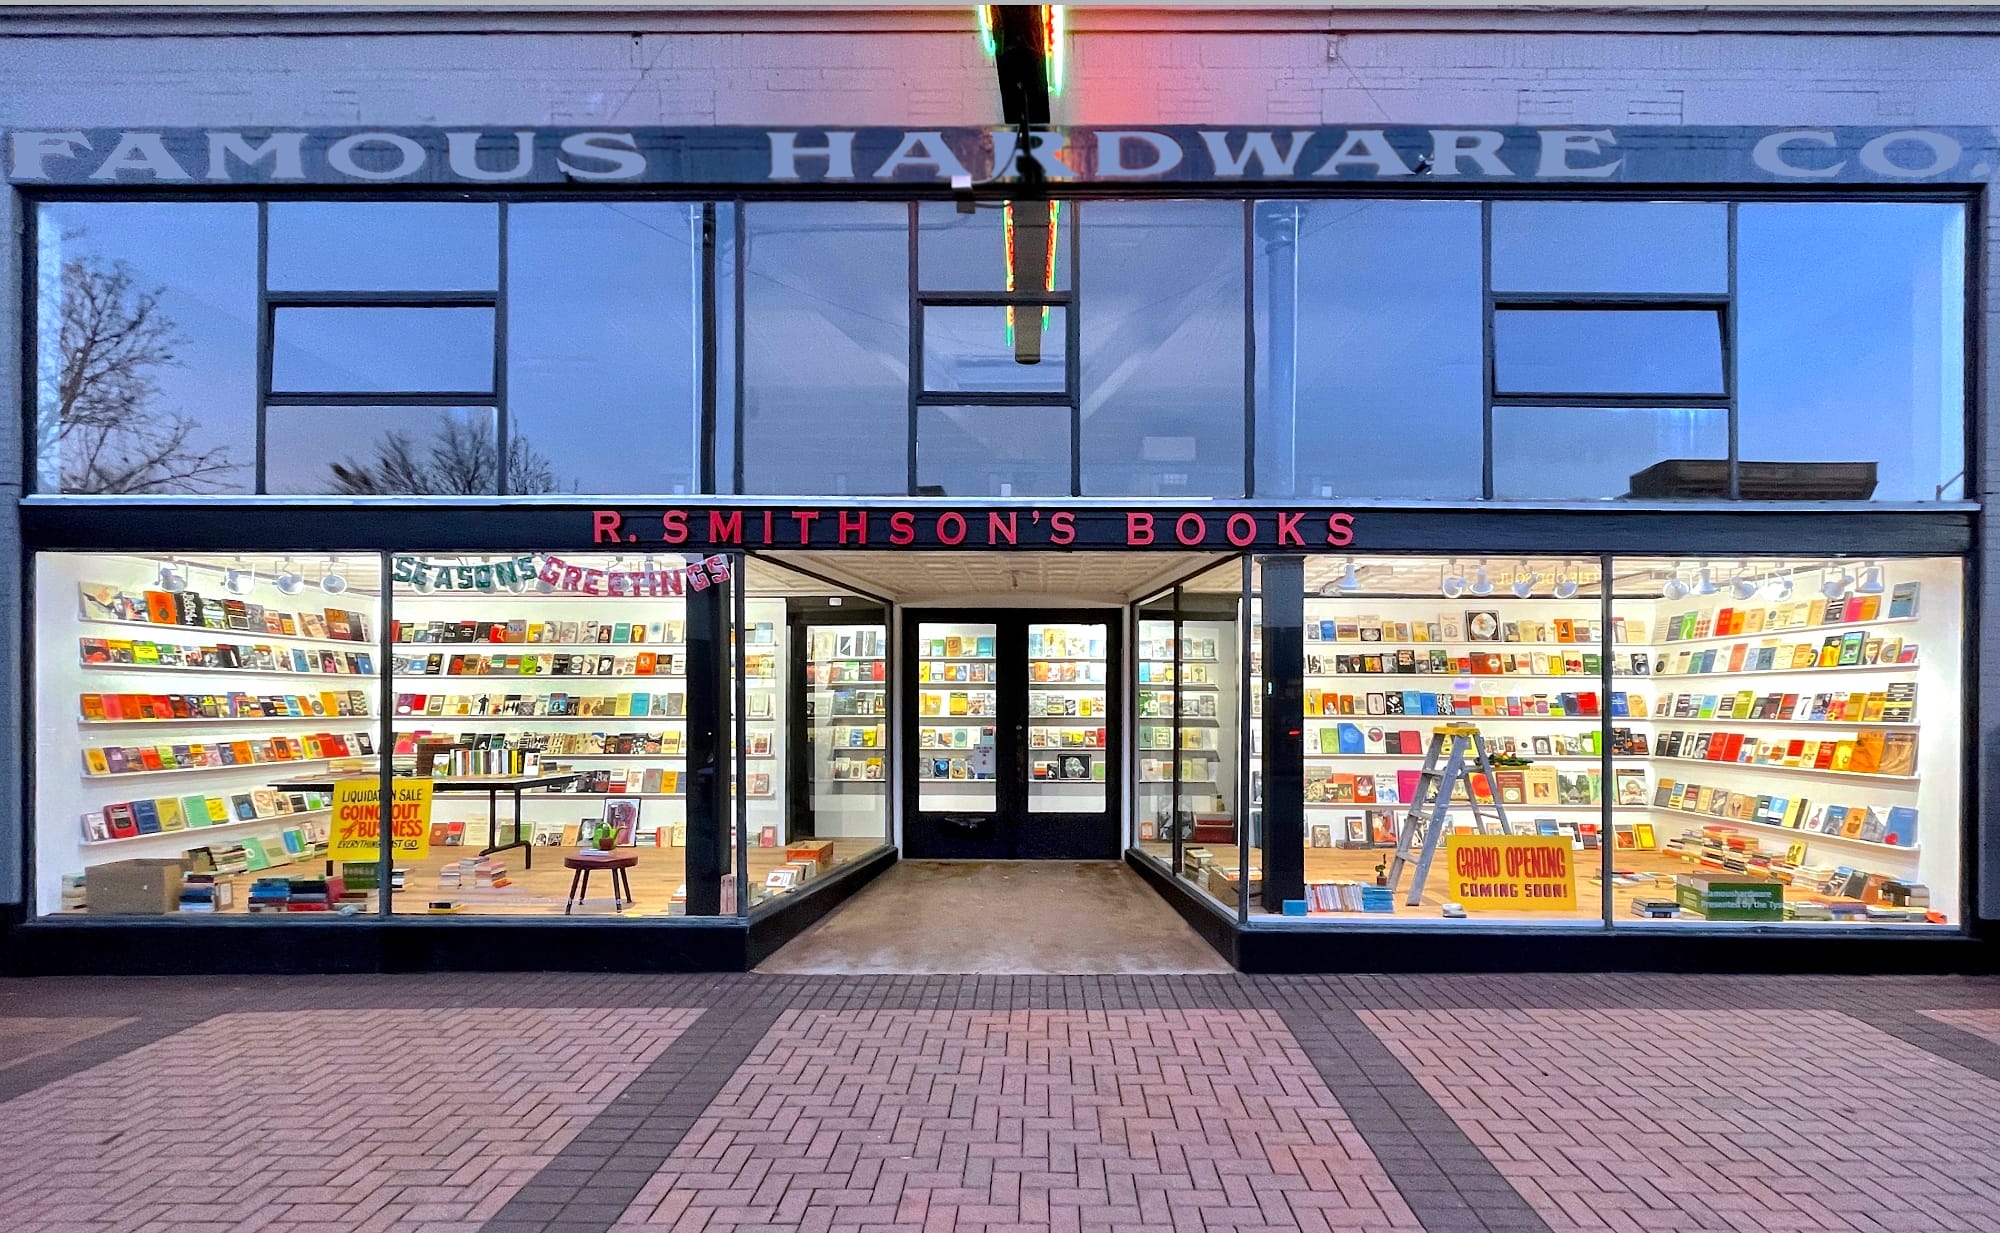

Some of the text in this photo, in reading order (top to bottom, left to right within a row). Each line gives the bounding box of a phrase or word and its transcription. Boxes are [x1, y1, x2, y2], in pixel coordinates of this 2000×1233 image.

[9, 128, 1991, 181] FAMOUS HARDWARE CO.
[592, 509, 1356, 548] R. SMITHSON'S BOOKS
[393, 553, 731, 597] SEASONS GREETINGS
[341, 788, 423, 803] LIQUIDATN SALE
[392, 803, 421, 820] OUT
[340, 820, 423, 839] of BUNESS
[338, 840, 381, 848] EVERYTHING
[404, 839, 418, 848] GO
[1456, 846, 1567, 880] GRAND OPENING
[1459, 882, 1568, 898] COMING SOON!
